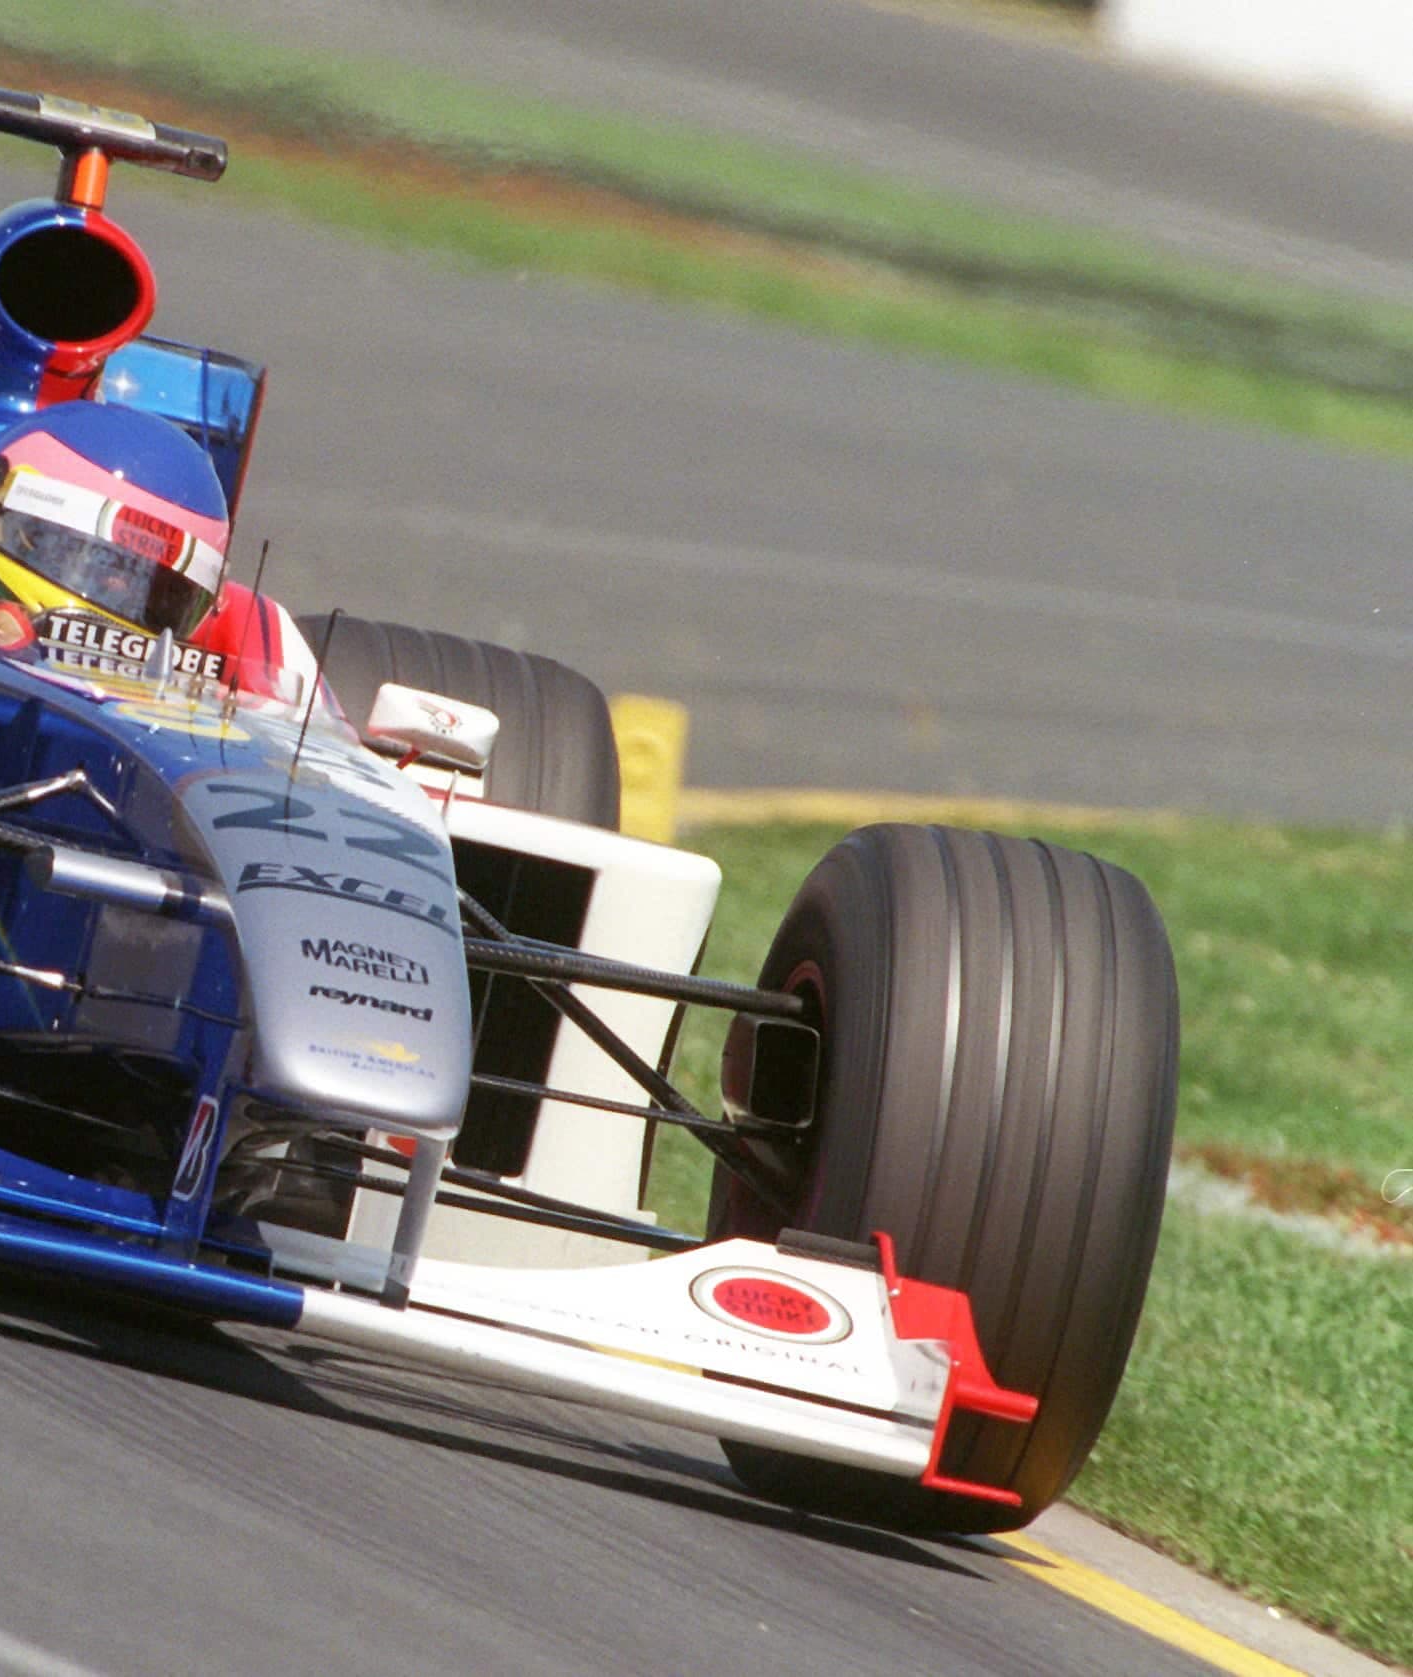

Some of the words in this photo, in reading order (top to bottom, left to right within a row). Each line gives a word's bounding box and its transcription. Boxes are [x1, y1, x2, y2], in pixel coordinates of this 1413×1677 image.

[122, 506, 185, 541] LUCKY
[117, 526, 179, 563] STRIKE
[206, 783, 454, 887] 22
[301, 938, 429, 977] MAGNETI
[301, 944, 429, 985] MARELLI
[309, 985, 433, 1022] reynard
[725, 1297, 815, 1326] STRIKE
[727, 1285, 813, 1313] LUCKY
